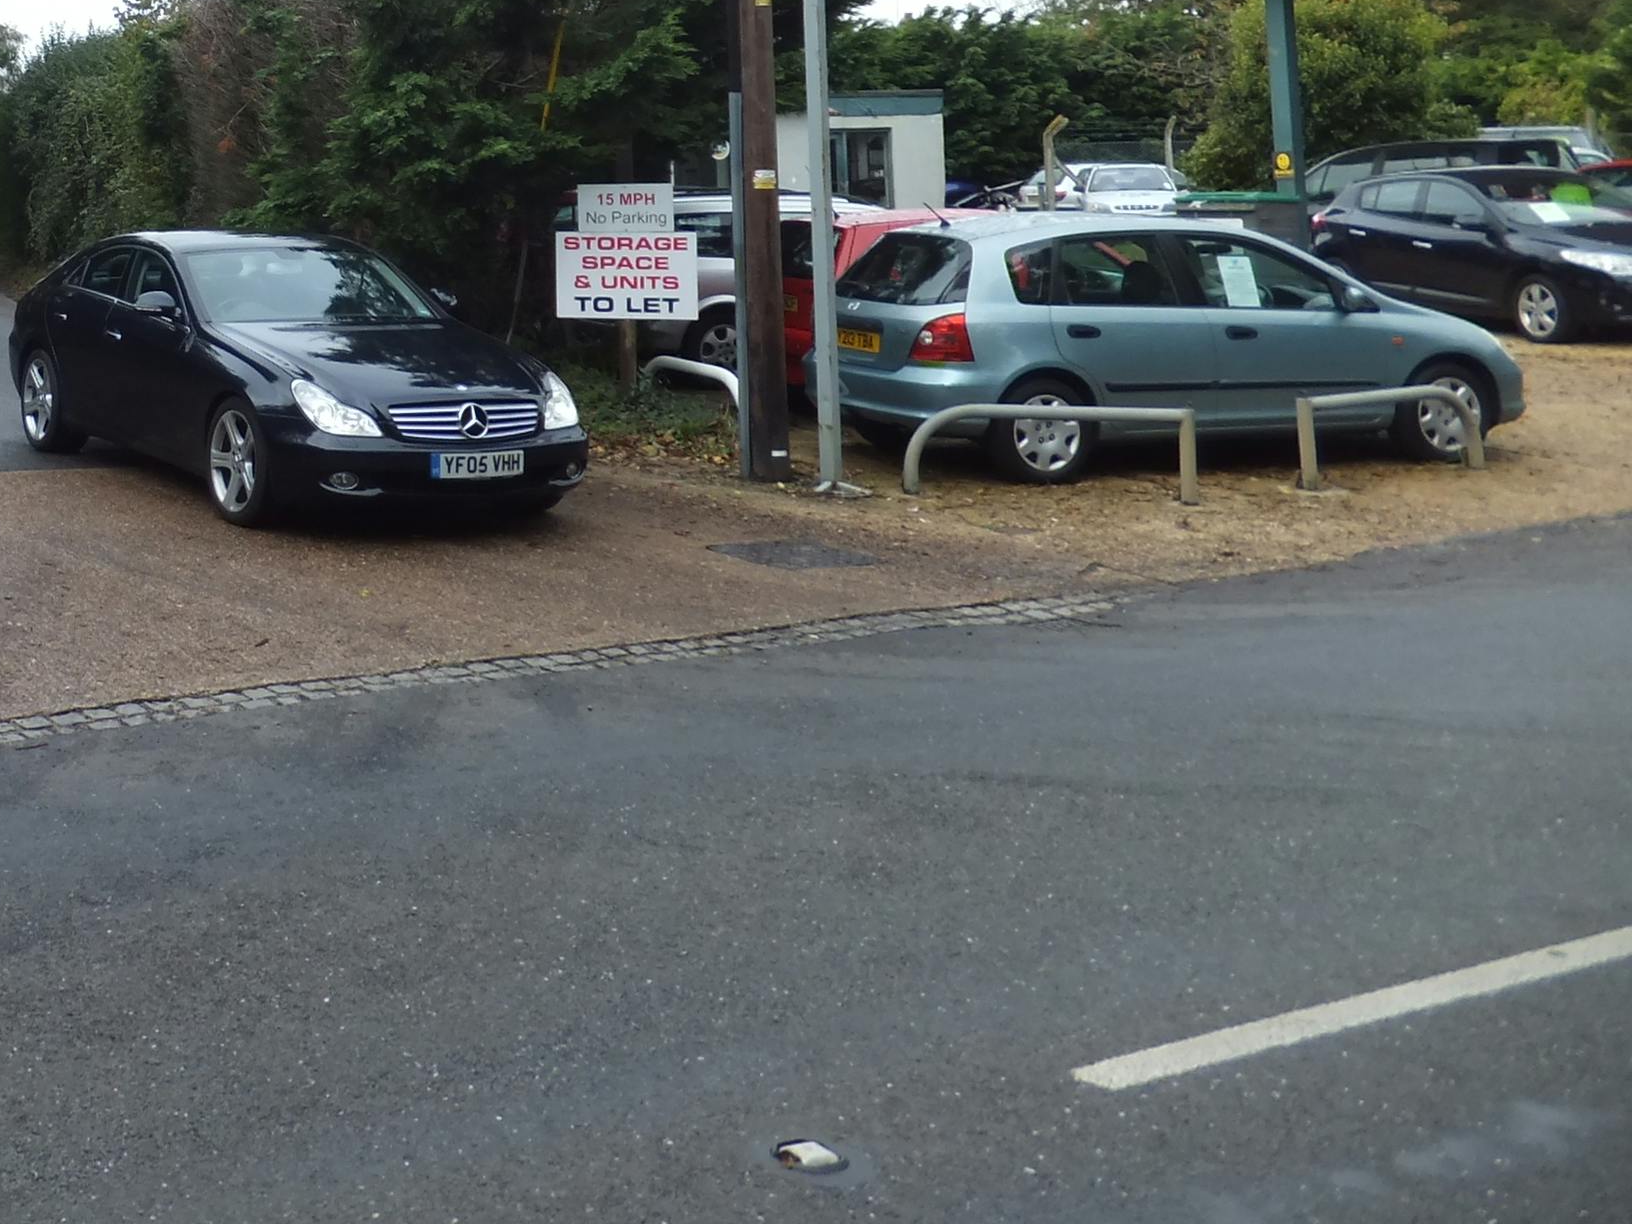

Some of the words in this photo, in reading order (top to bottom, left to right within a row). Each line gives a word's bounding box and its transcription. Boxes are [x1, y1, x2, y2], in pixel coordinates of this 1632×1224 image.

[597, 193, 614, 205] 15
[620, 193, 655, 205] MPH
[586, 212, 606, 224] No
[612, 211, 667, 226] Parking
[564, 237, 688, 250] STORAGE
[582, 256, 669, 270] SPACE
[575, 275, 591, 289] &
[601, 276, 679, 290] UNITS
[574, 297, 614, 313] TO
[626, 297, 680, 313] LET
[445, 456, 488, 473] YF05
[493, 454, 521, 472] VHH
